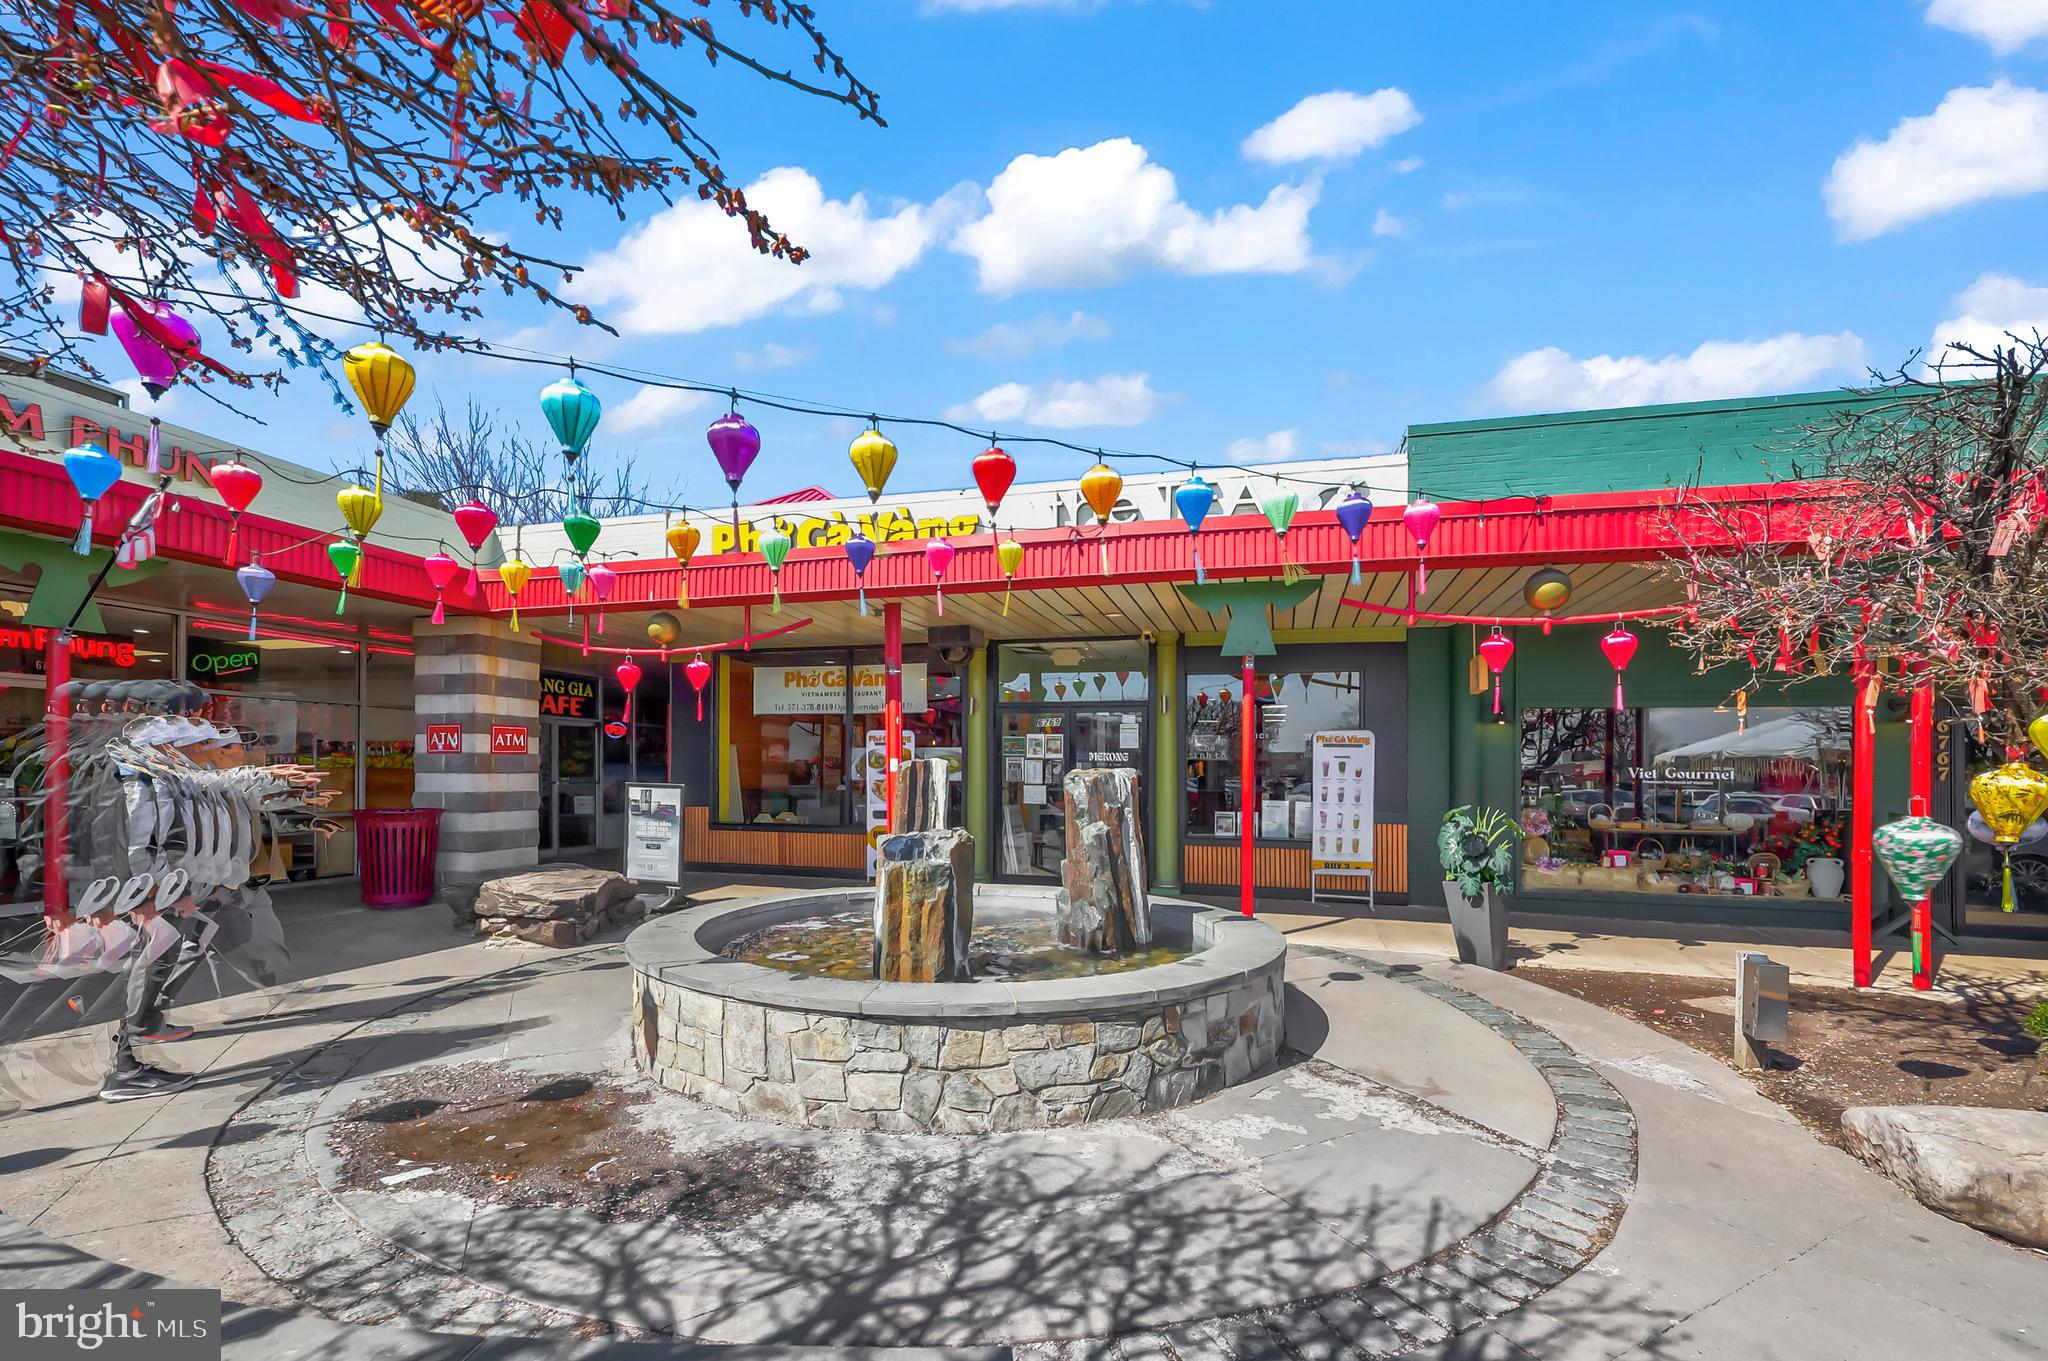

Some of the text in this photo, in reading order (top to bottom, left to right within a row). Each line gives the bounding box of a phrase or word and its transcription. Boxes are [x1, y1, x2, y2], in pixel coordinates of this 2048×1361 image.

[71, 415, 247, 488] PHUN
[797, 510, 852, 548] Gà
[858, 507, 979, 543] Vàng
[191, 650, 258, 675] Open
[852, 668, 886, 687] Vàn
[541, 677, 594, 697] NG GIA
[801, 690, 840, 698] VIETNAMESE
[853, 703, 879, 712] veryday
[1038, 718, 1060, 726] 6769
[430, 732, 458, 747] ATM
[495, 733, 525, 746] ATM
[1088, 752, 1129, 762] MEKONG
[1936, 720, 1950, 781] 6767
